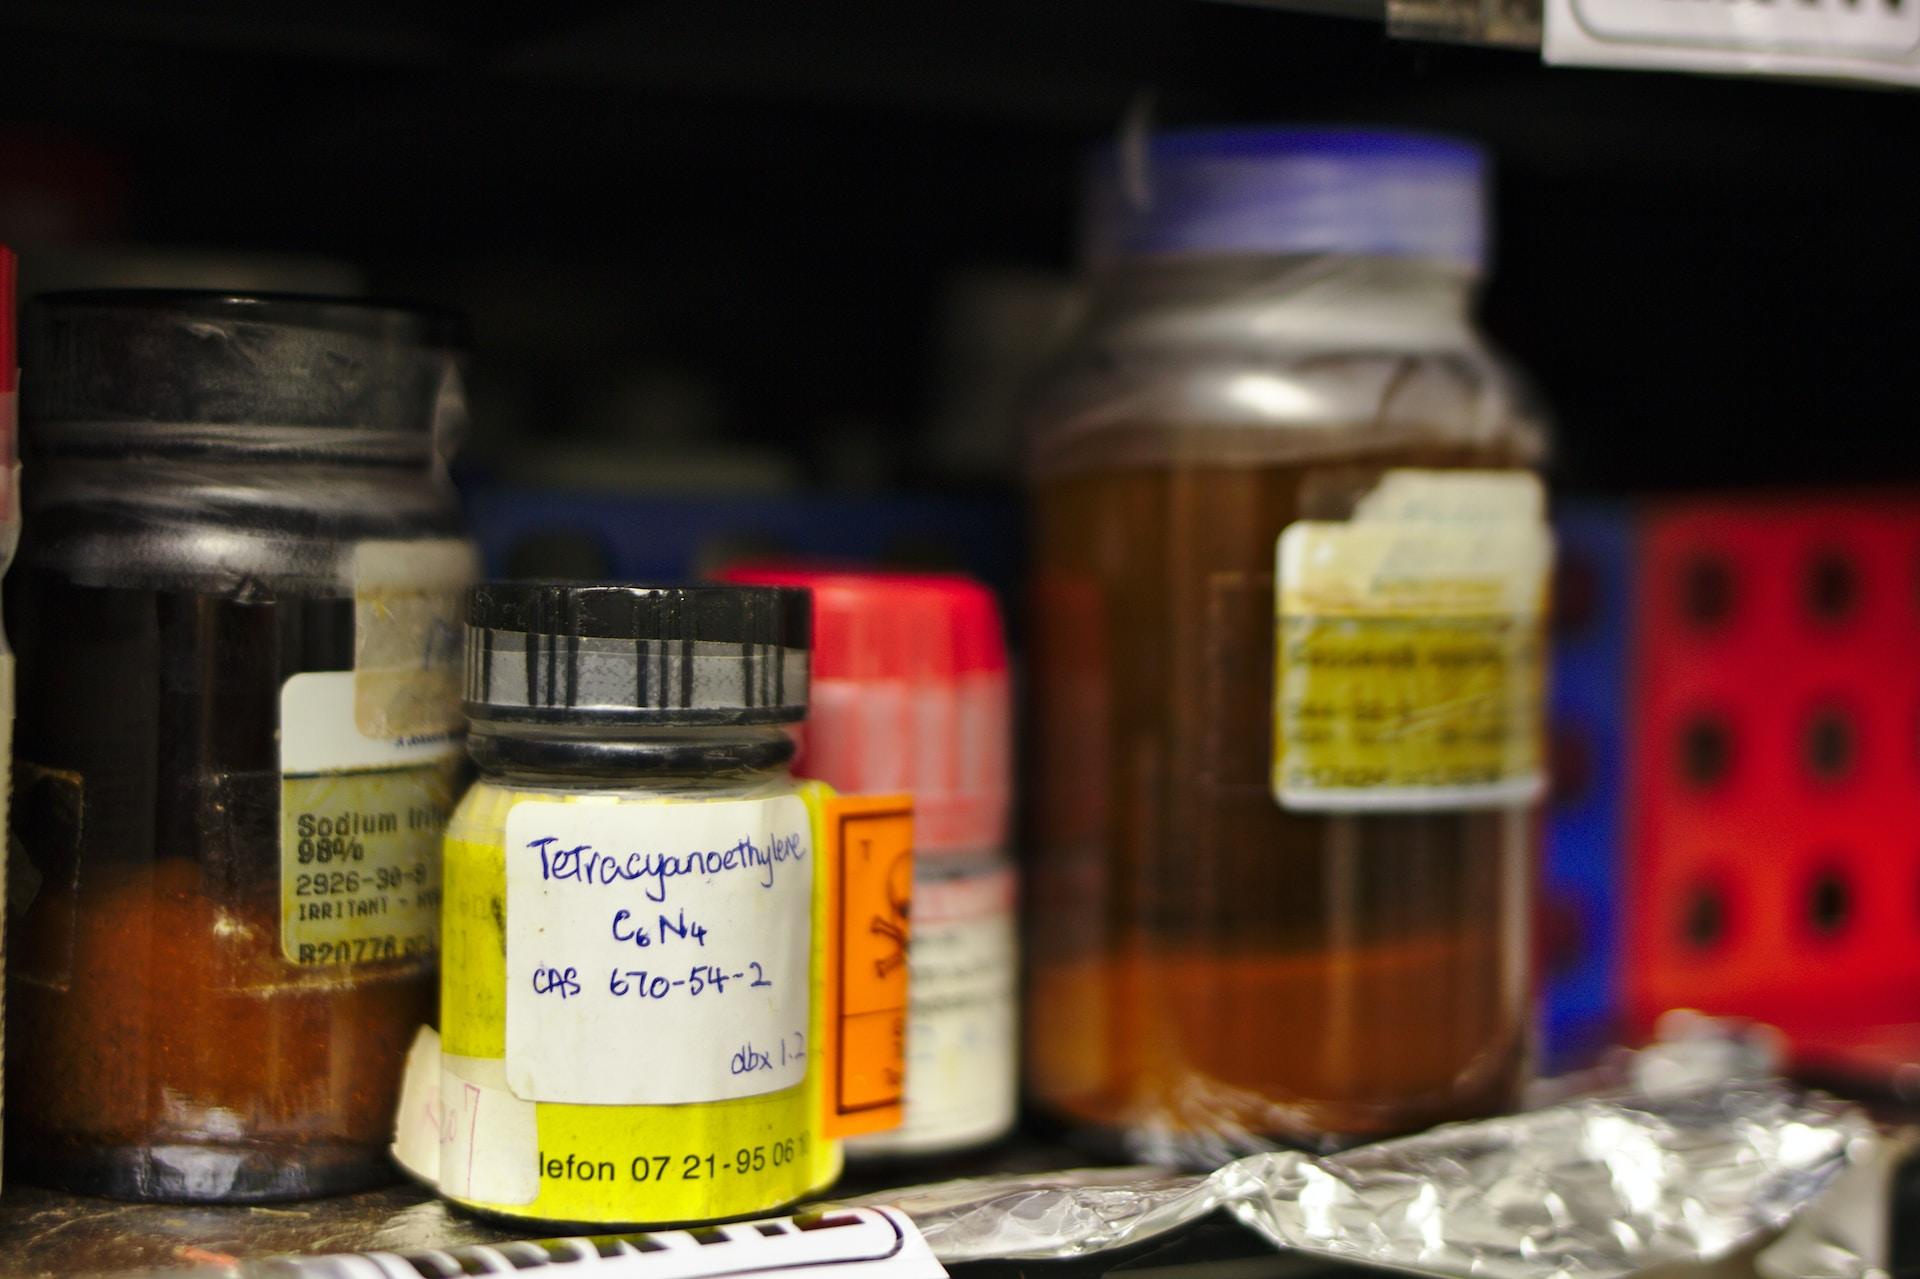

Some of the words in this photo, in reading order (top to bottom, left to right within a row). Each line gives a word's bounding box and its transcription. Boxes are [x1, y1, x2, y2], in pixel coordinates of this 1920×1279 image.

[298, 812, 398, 838] Sodium
[297, 837, 364, 865] 98%
[298, 895, 389, 922] IRRITANT
[532, 966, 581, 1000] CAS
[609, 961, 772, 999] 670-54-2
[630, 1155, 671, 1182] 07
[682, 1145, 766, 1180] 21-95
[772, 1138, 794, 1168] 06
